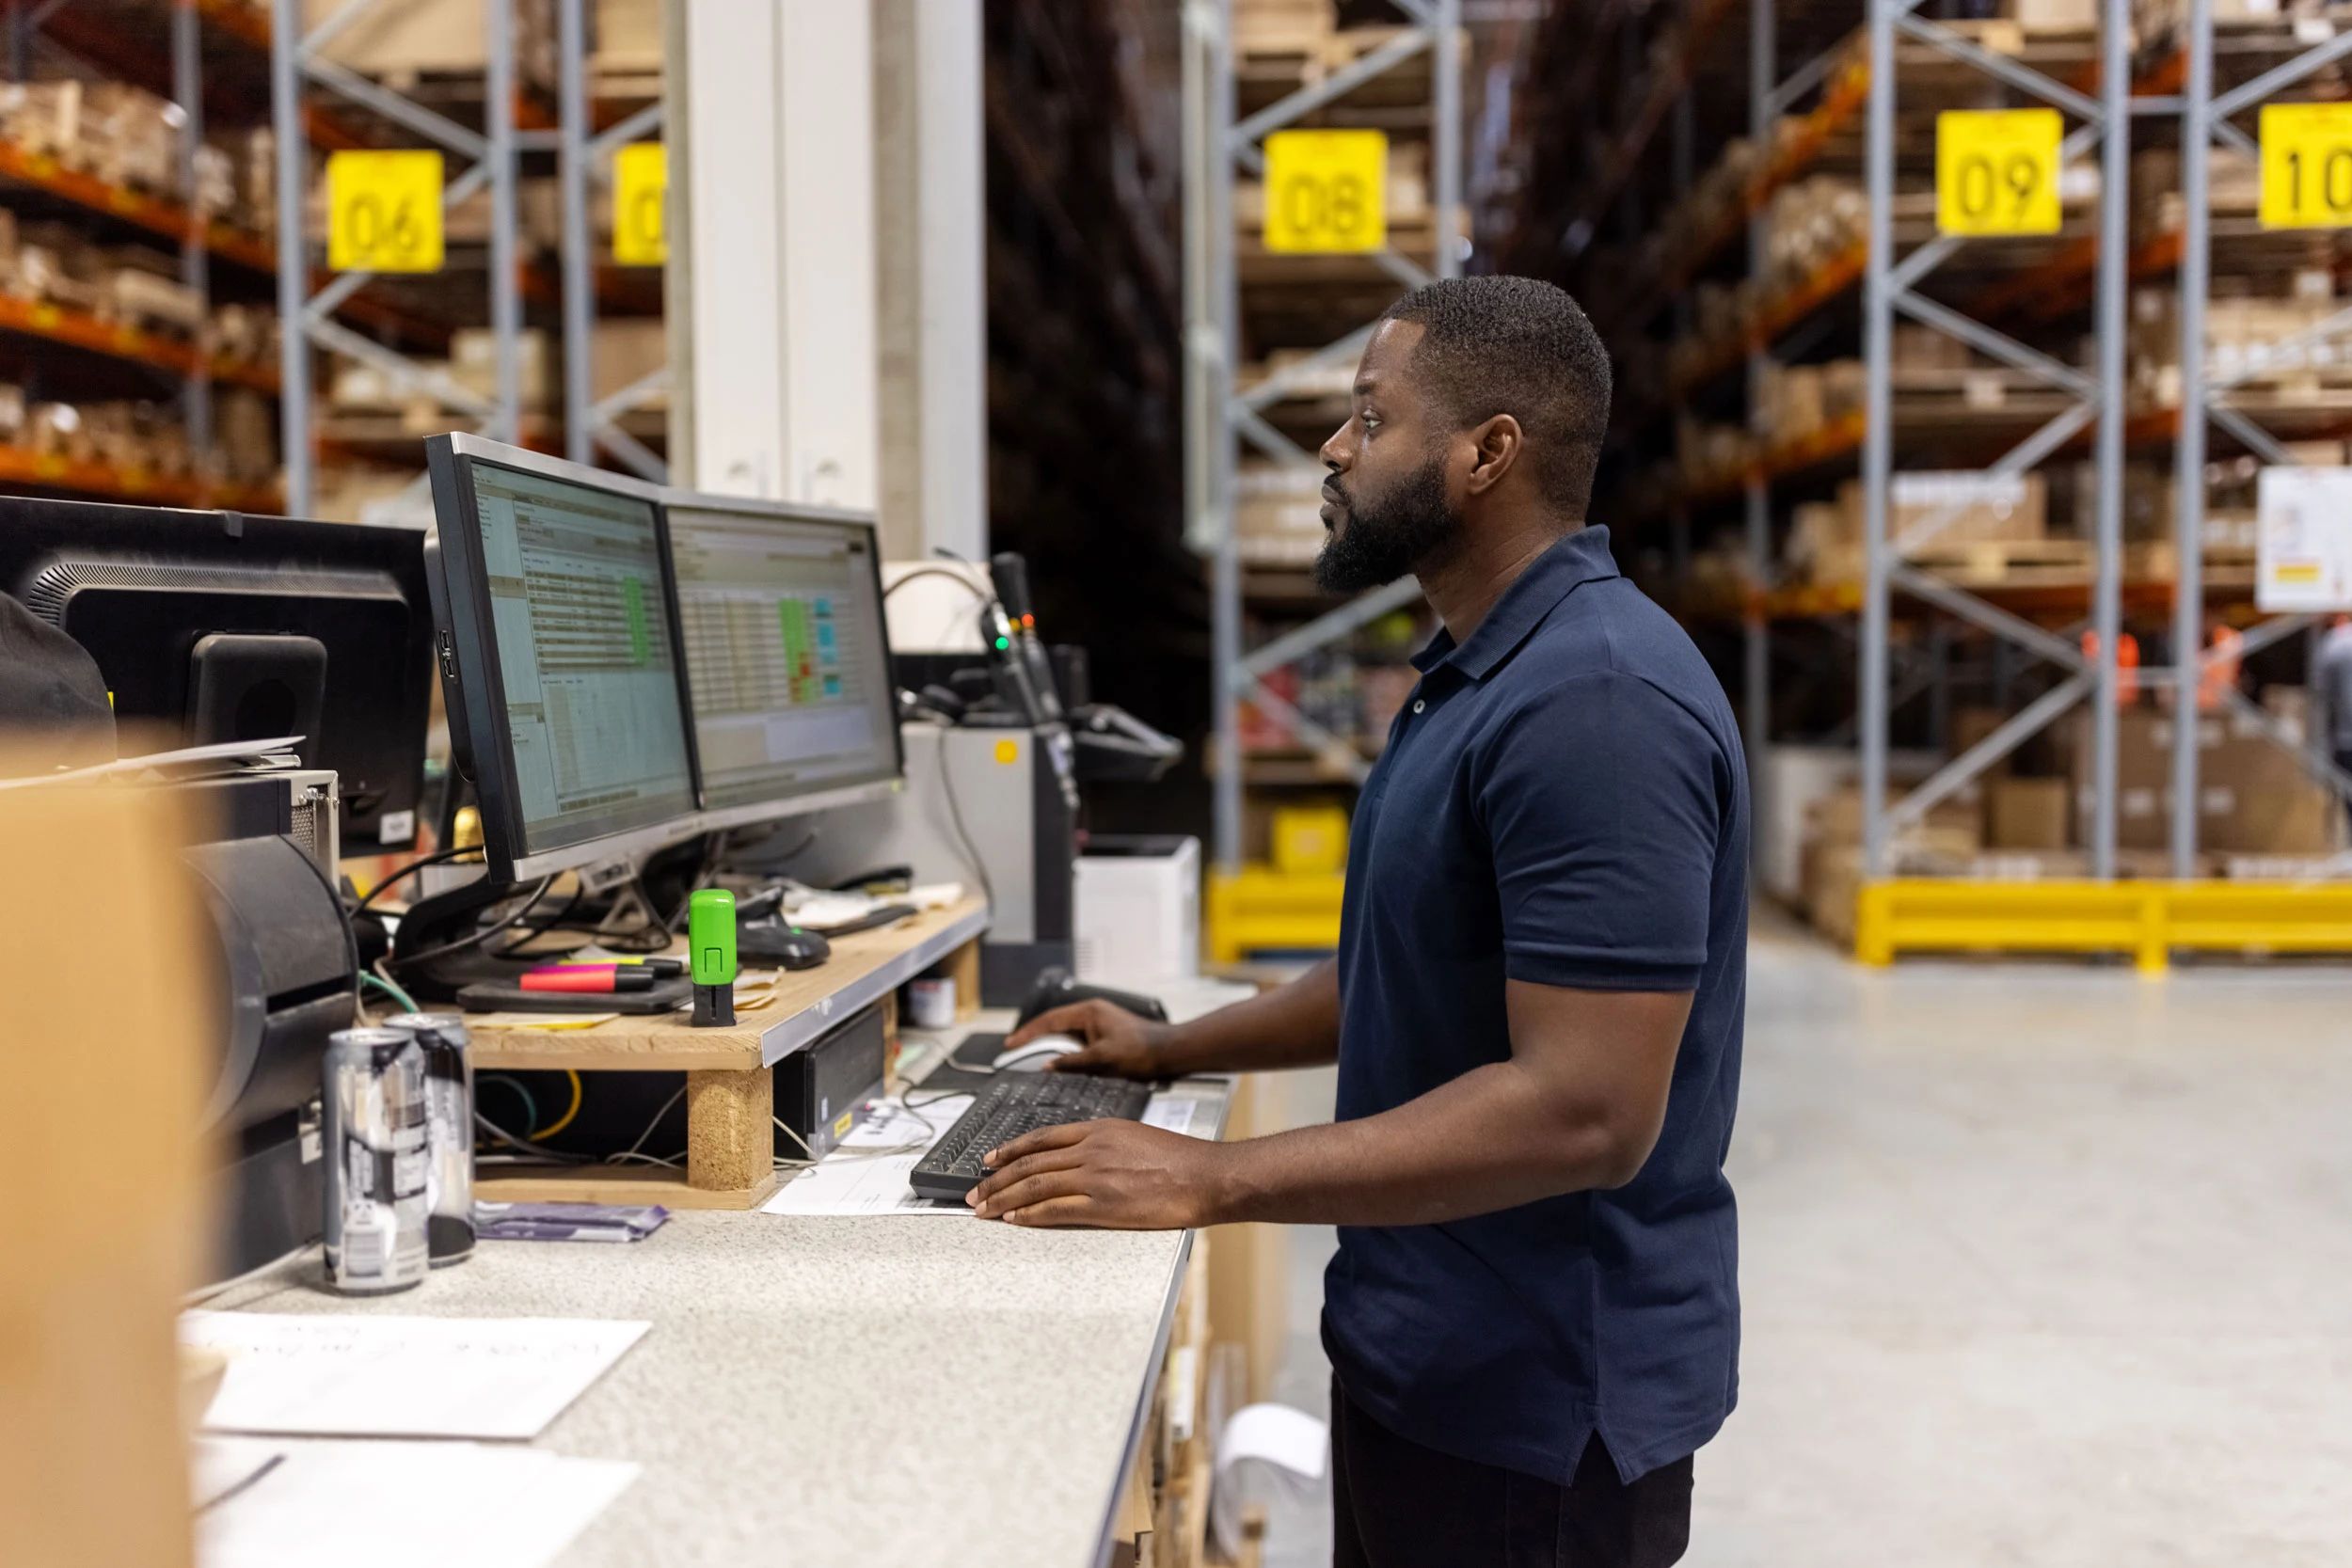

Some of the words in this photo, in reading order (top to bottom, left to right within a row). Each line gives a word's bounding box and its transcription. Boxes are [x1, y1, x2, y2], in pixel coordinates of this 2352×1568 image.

[1281, 173, 1366, 235] 08
[1957, 153, 2040, 223] 09
[2285, 149, 2352, 213] 10
[344, 192, 424, 255] 06
